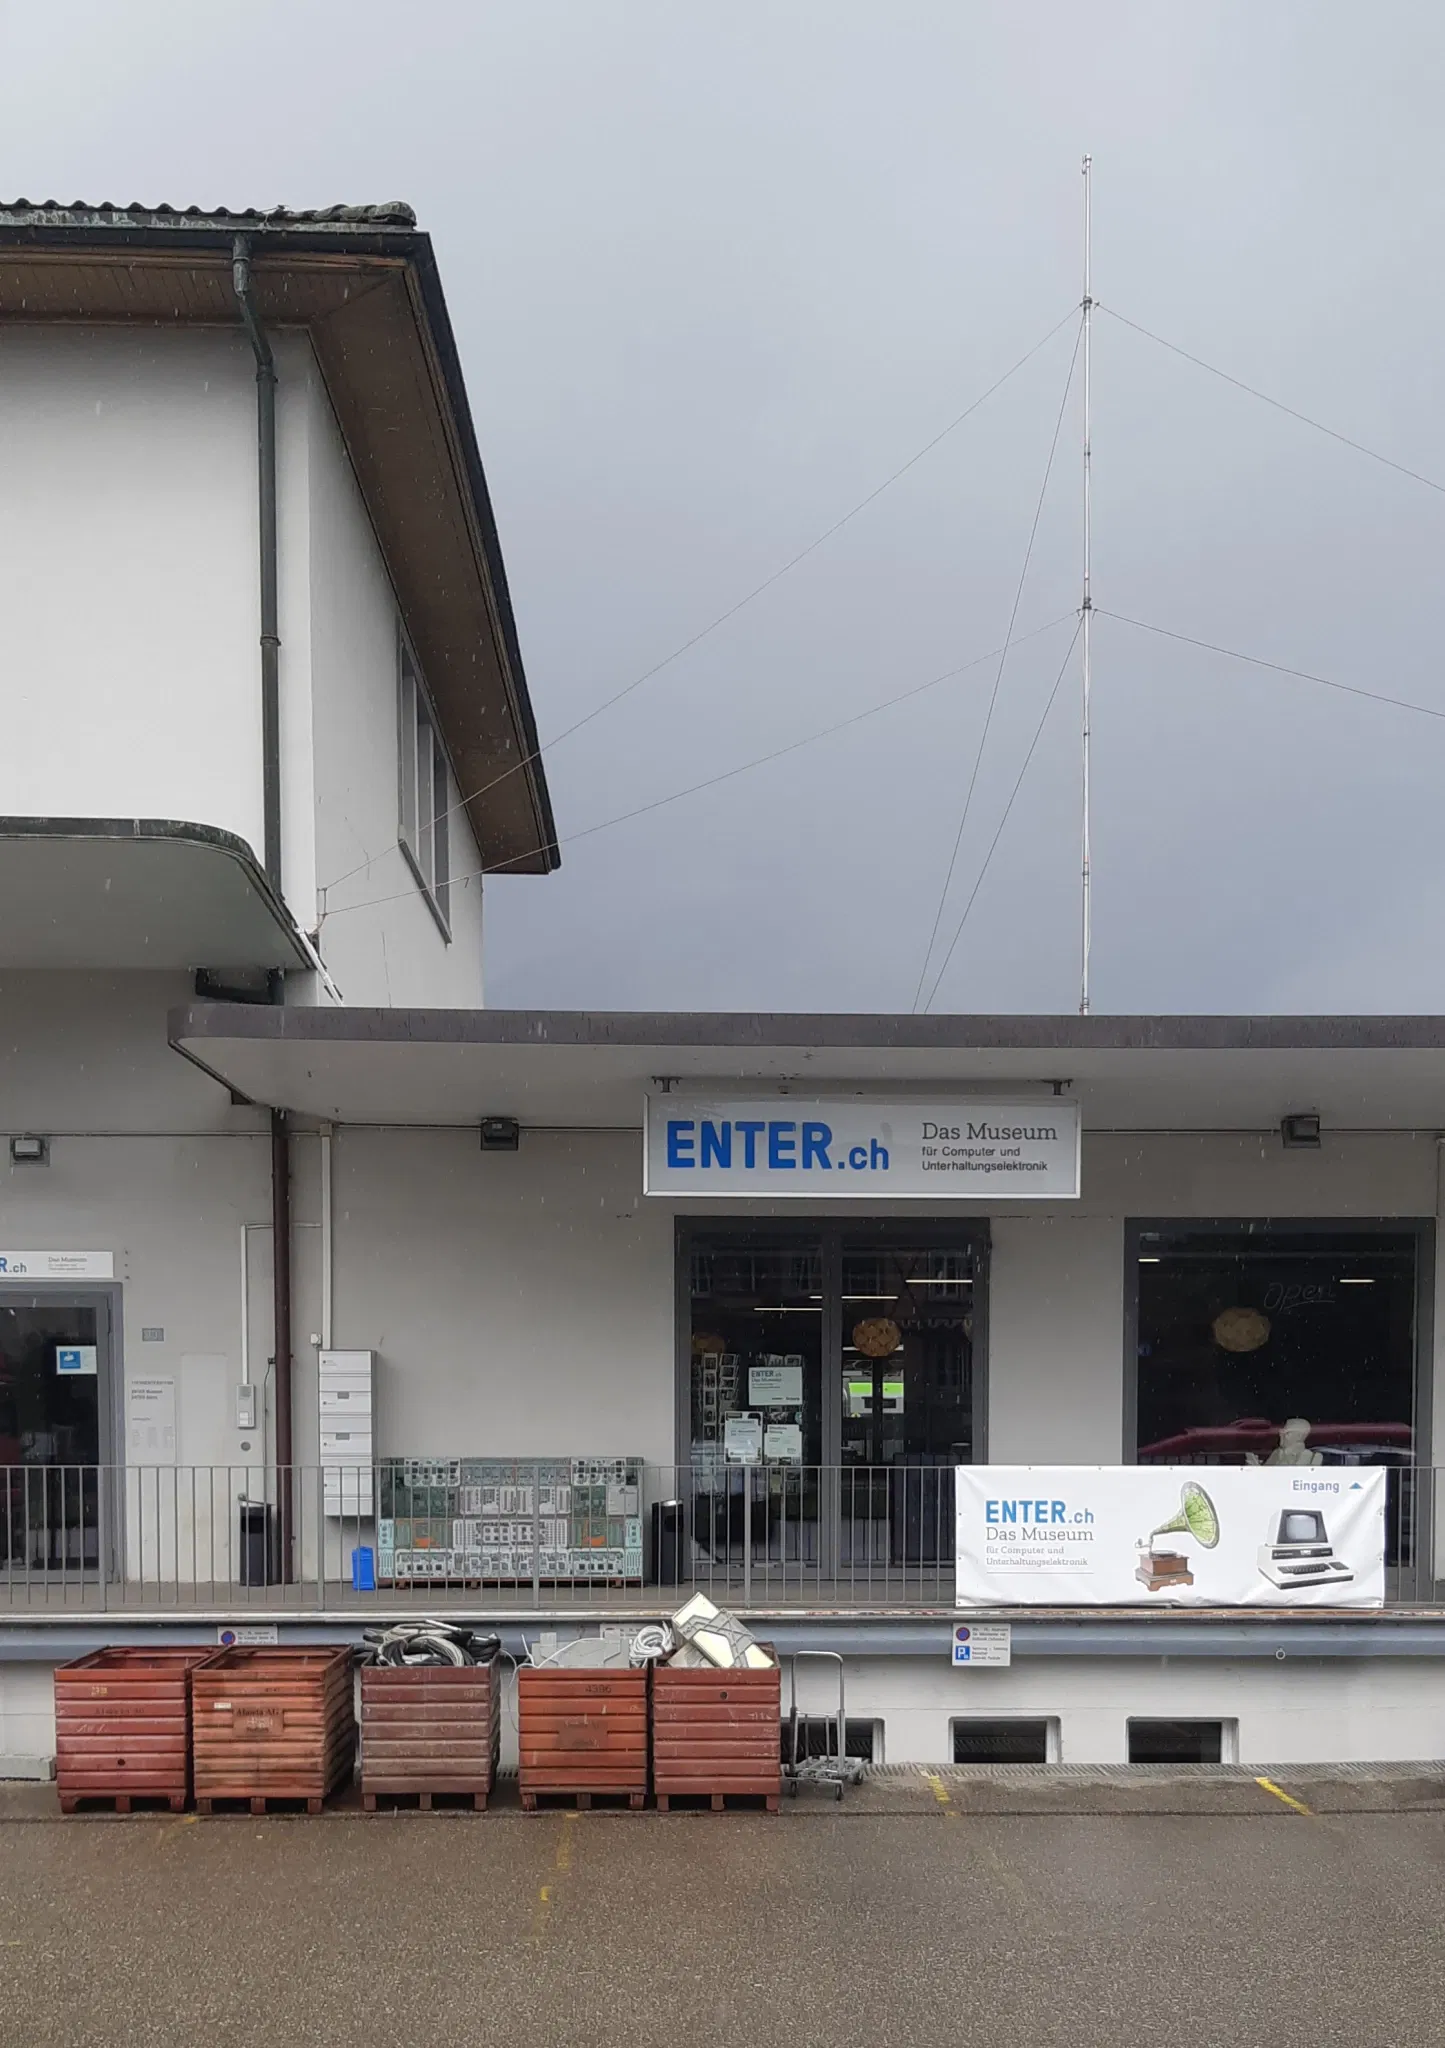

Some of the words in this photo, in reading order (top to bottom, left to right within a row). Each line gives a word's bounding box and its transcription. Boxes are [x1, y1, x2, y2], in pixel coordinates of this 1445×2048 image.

[922, 1122, 960, 1140] Das
[966, 1122, 1058, 1140] Museum
[667, 1120, 889, 1170] ENTER.ch
[922, 1146, 938, 1157] für
[942, 1146, 996, 1158] Computer
[1000, 1146, 1020, 1157] und
[922, 1160, 1048, 1173] Unterhaltungselektronik
[1292, 1480, 1340, 1494] Eingang
[985, 1500, 1095, 1524] ENTER.ch
[985, 1526, 1017, 1541] Das
[1021, 1526, 1095, 1541] Museum
[986, 1546, 999, 1555] für
[1000, 1546, 1045, 1557] Computer
[1047, 1546, 1065, 1555] und
[986, 1558, 1088, 1568] Unterhaltungselektronik
